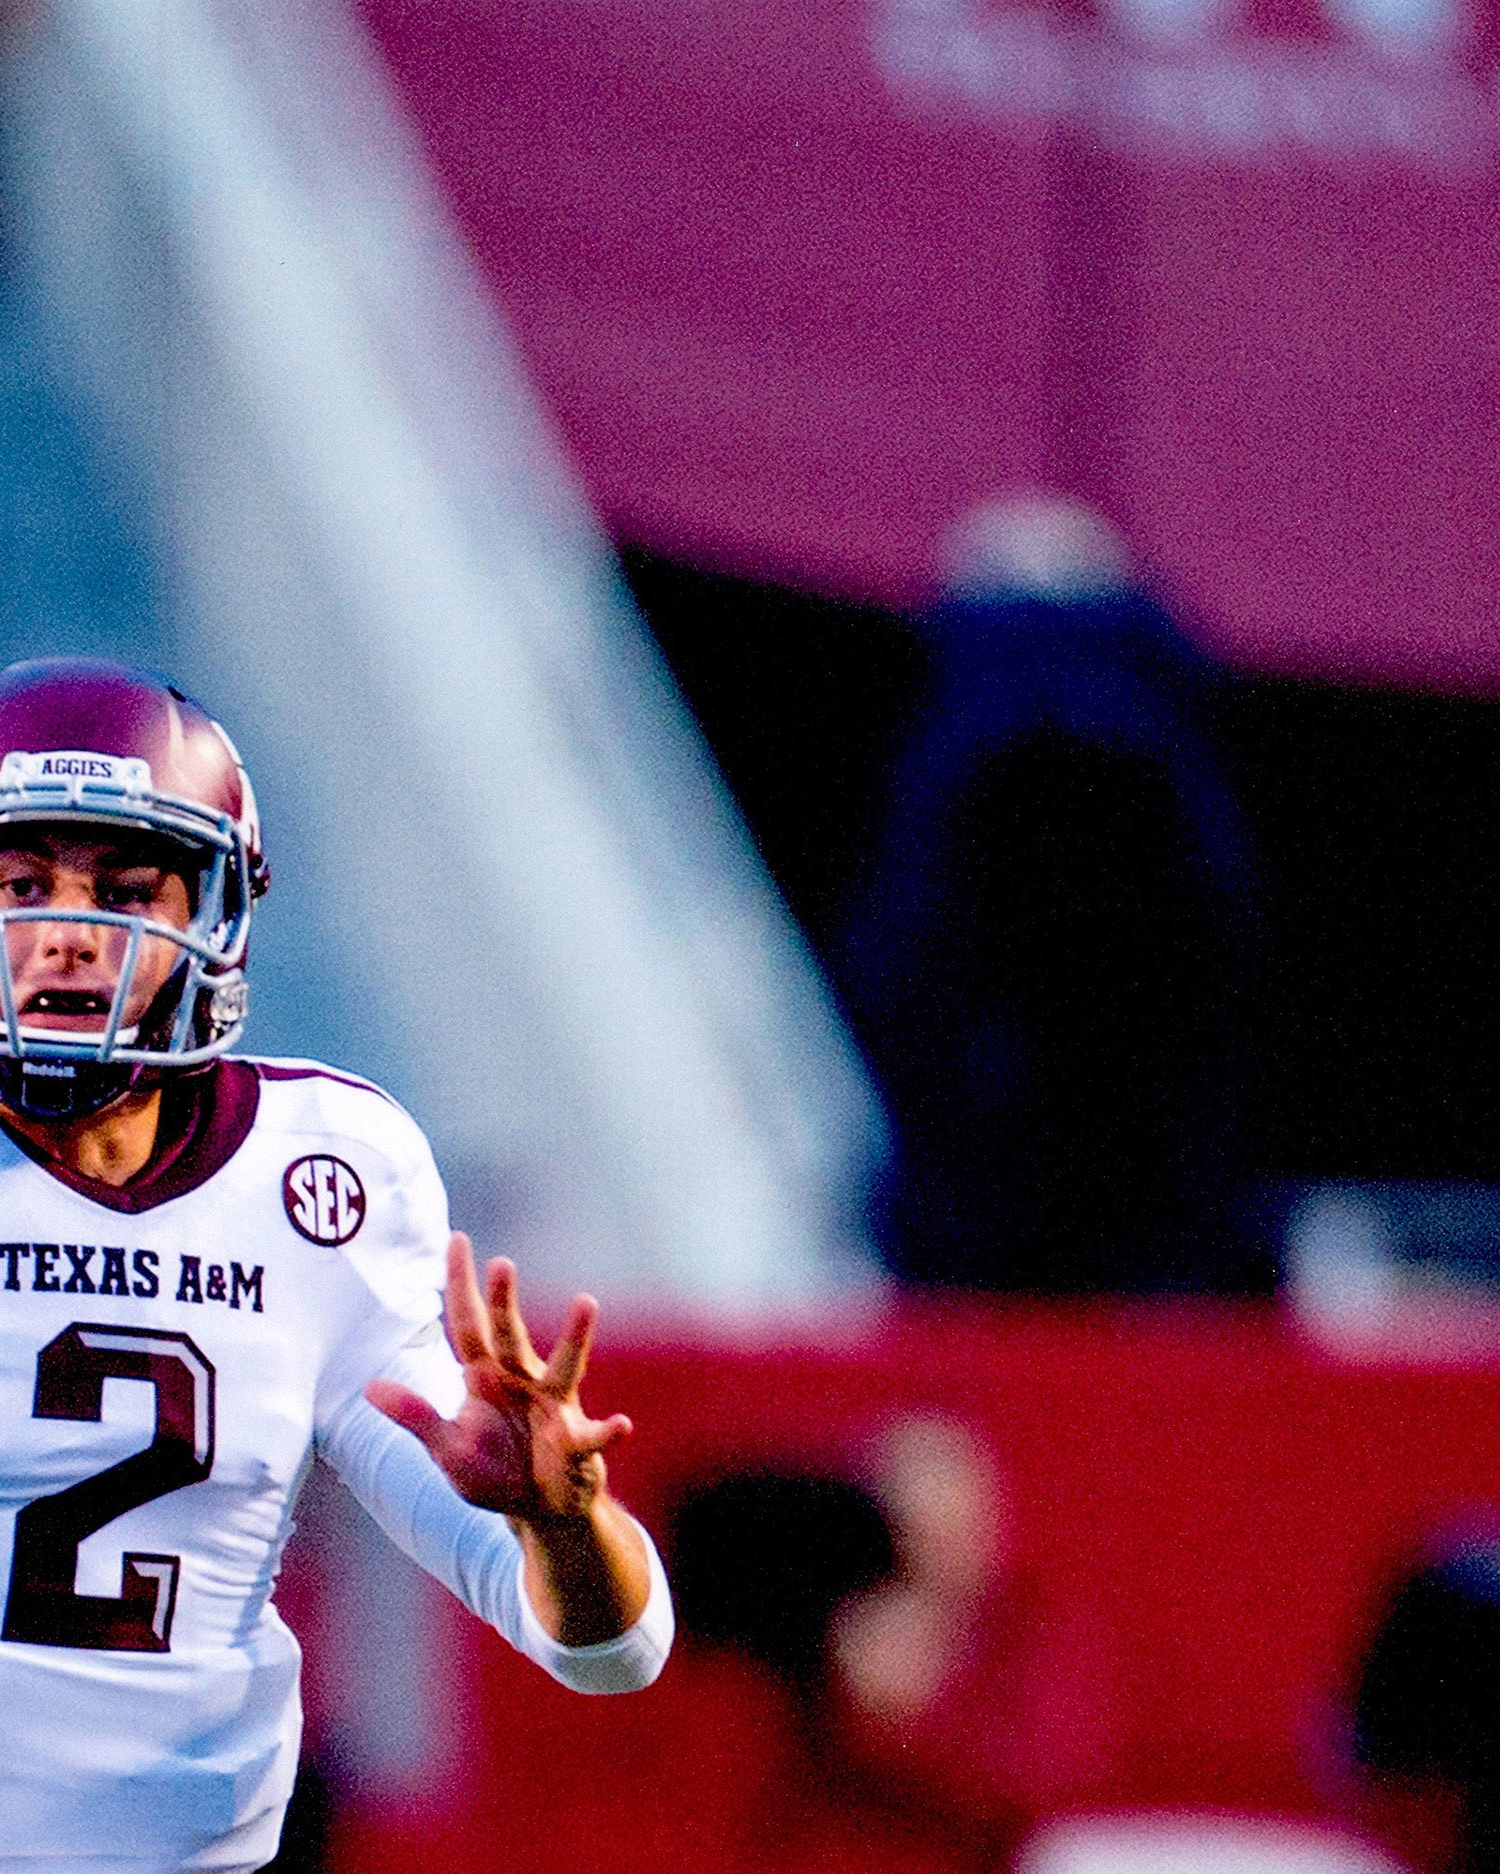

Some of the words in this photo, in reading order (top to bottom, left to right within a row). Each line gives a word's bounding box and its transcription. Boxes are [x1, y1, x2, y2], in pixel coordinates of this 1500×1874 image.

[42, 758, 112, 778] AGGIES
[287, 1157, 362, 1242] SEC
[175, 1254, 265, 1313] A&M
[0, 1321, 217, 1653] 2
